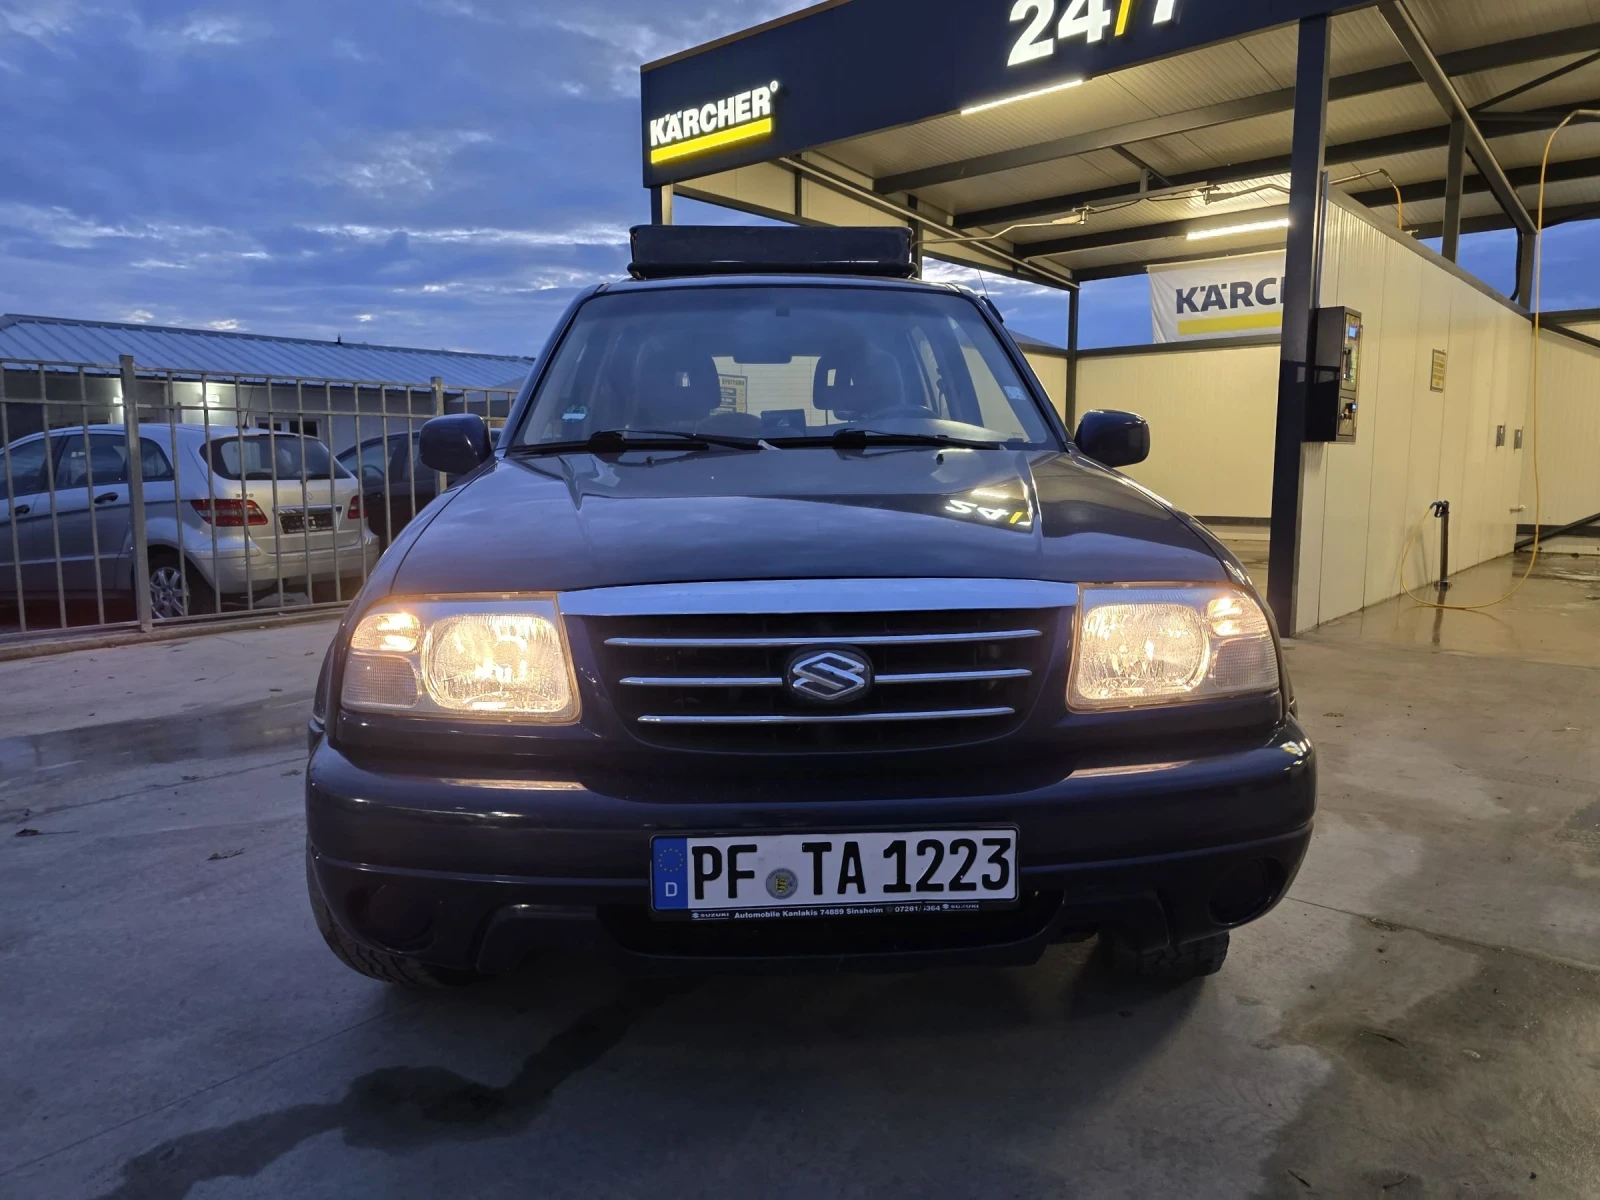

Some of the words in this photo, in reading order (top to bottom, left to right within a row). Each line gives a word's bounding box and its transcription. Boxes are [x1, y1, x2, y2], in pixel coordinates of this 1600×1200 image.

[650, 86, 771, 147] KÄRCHER
[1176, 276, 1285, 314] KÄRC
[692, 844, 757, 900] PF
[802, 841, 866, 895] TA
[883, 838, 1011, 893] 1223
[665, 882, 678, 897] D
[734, 911, 780, 919] Automobile
[846, 906, 884, 915] Sinsheim
